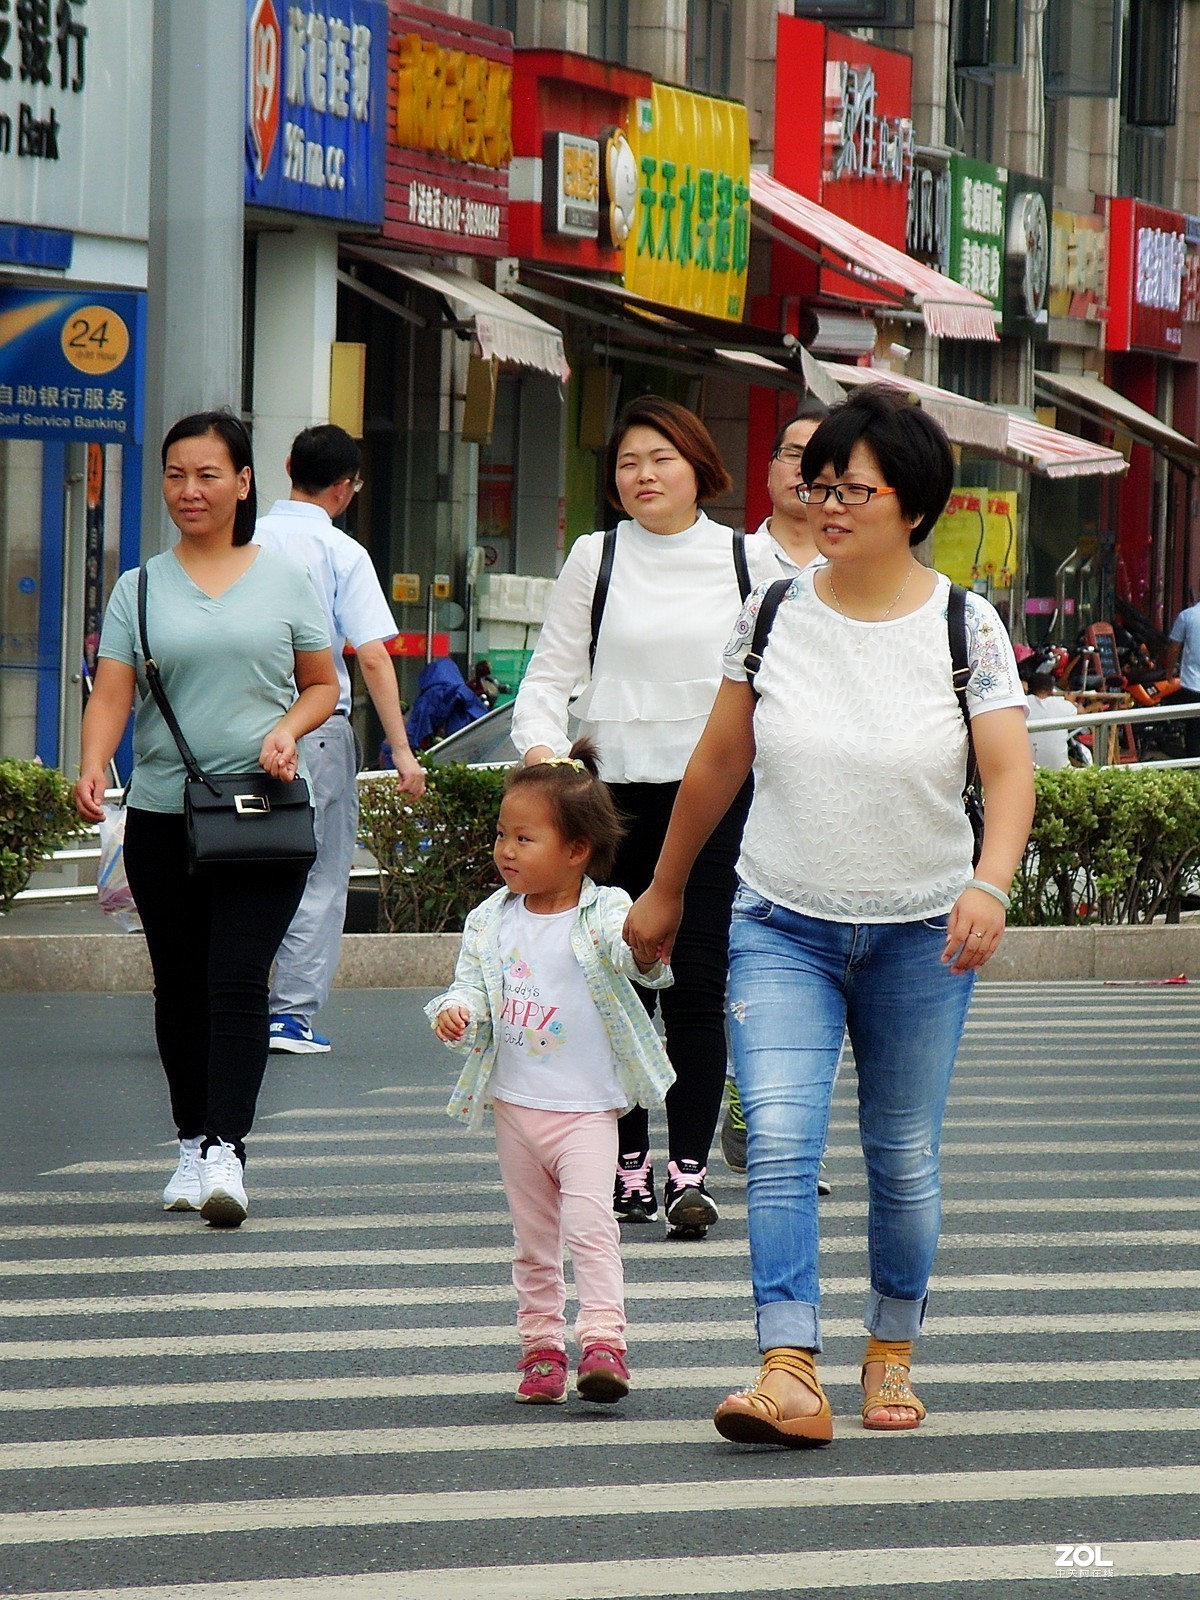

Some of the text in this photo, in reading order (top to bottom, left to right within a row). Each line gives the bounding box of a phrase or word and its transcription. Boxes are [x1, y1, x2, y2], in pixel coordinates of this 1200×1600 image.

[18, 102, 60, 160] Bank
[69, 319, 110, 349] 24
[0, 384, 128, 412] 自助银行服务
[22, 412, 72, 428] Service
[74, 415, 127, 433] Banking
[500, 997, 560, 1031] APPY
